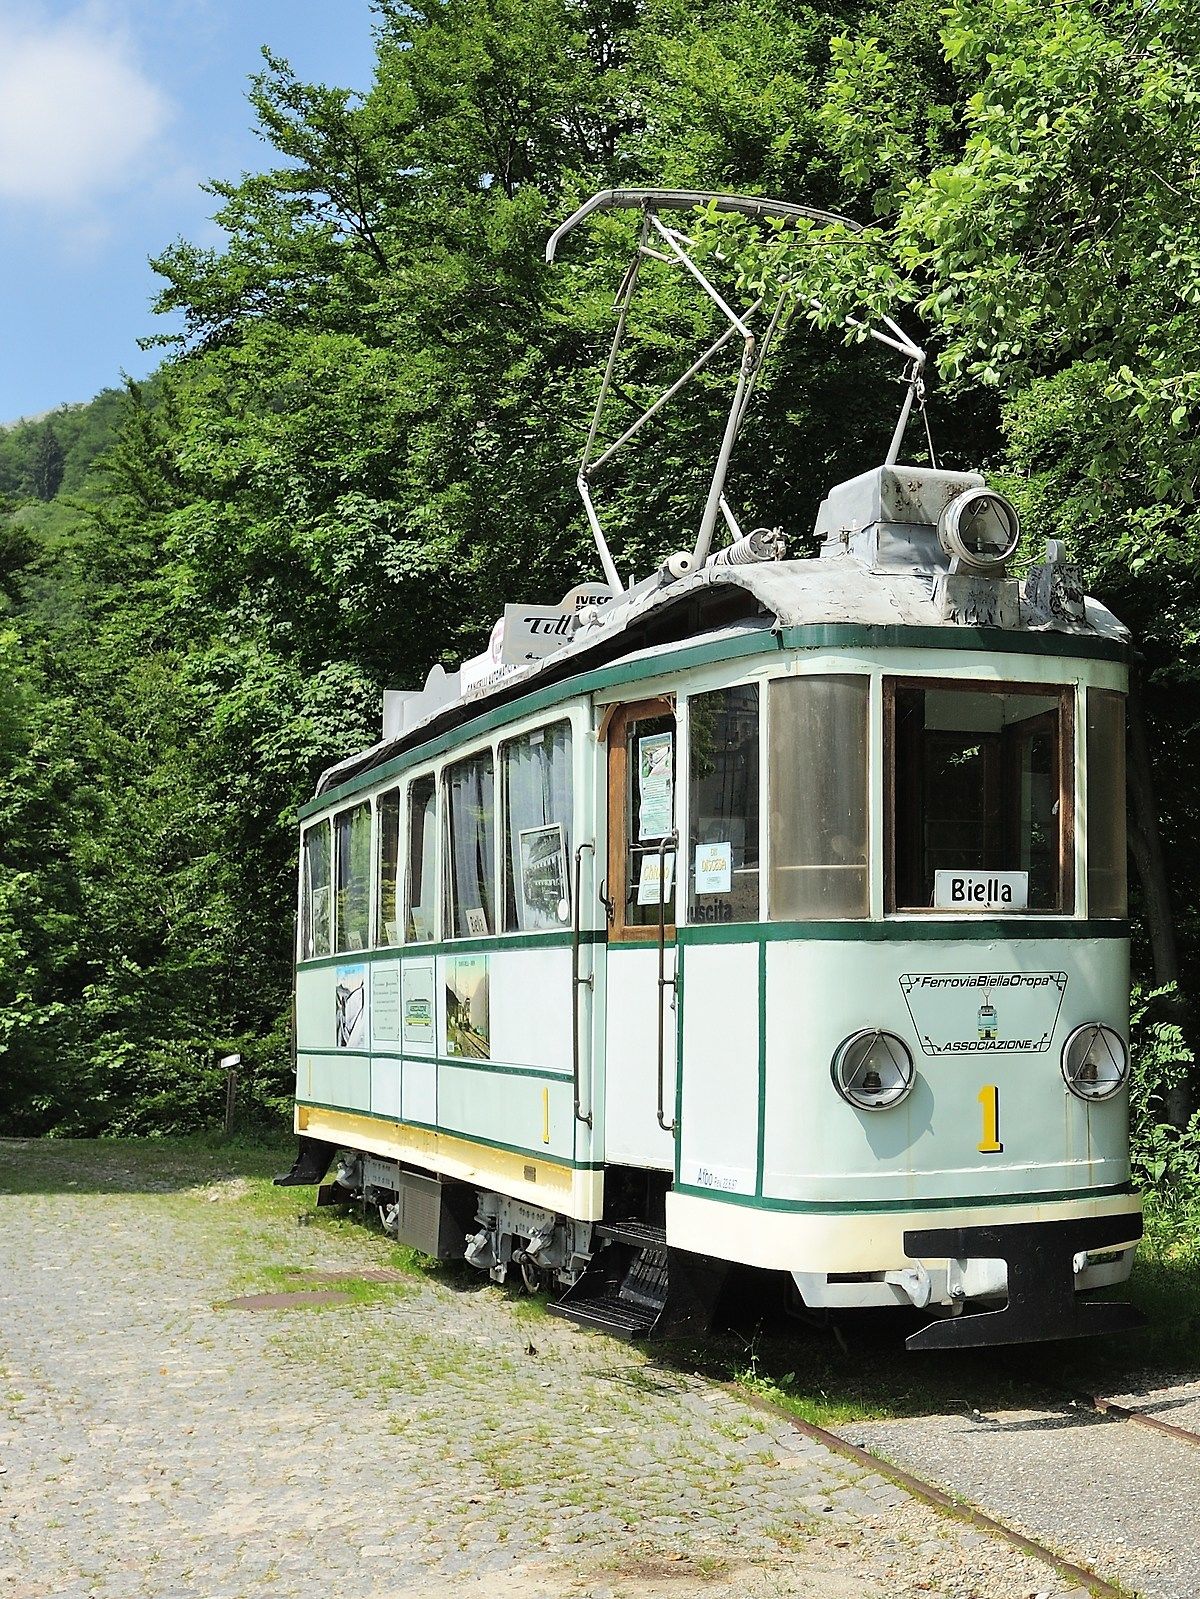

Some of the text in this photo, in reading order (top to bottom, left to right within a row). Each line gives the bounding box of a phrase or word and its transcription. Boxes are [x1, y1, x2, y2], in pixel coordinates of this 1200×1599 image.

[951, 878, 1012, 902] Biella
[689, 898, 733, 923] uscita
[920, 975, 1050, 988] FerroviaBiellaOropa
[943, 1040, 1033, 1051] ASSOCIAZIONE
[976, 1084, 1004, 1154] 1
